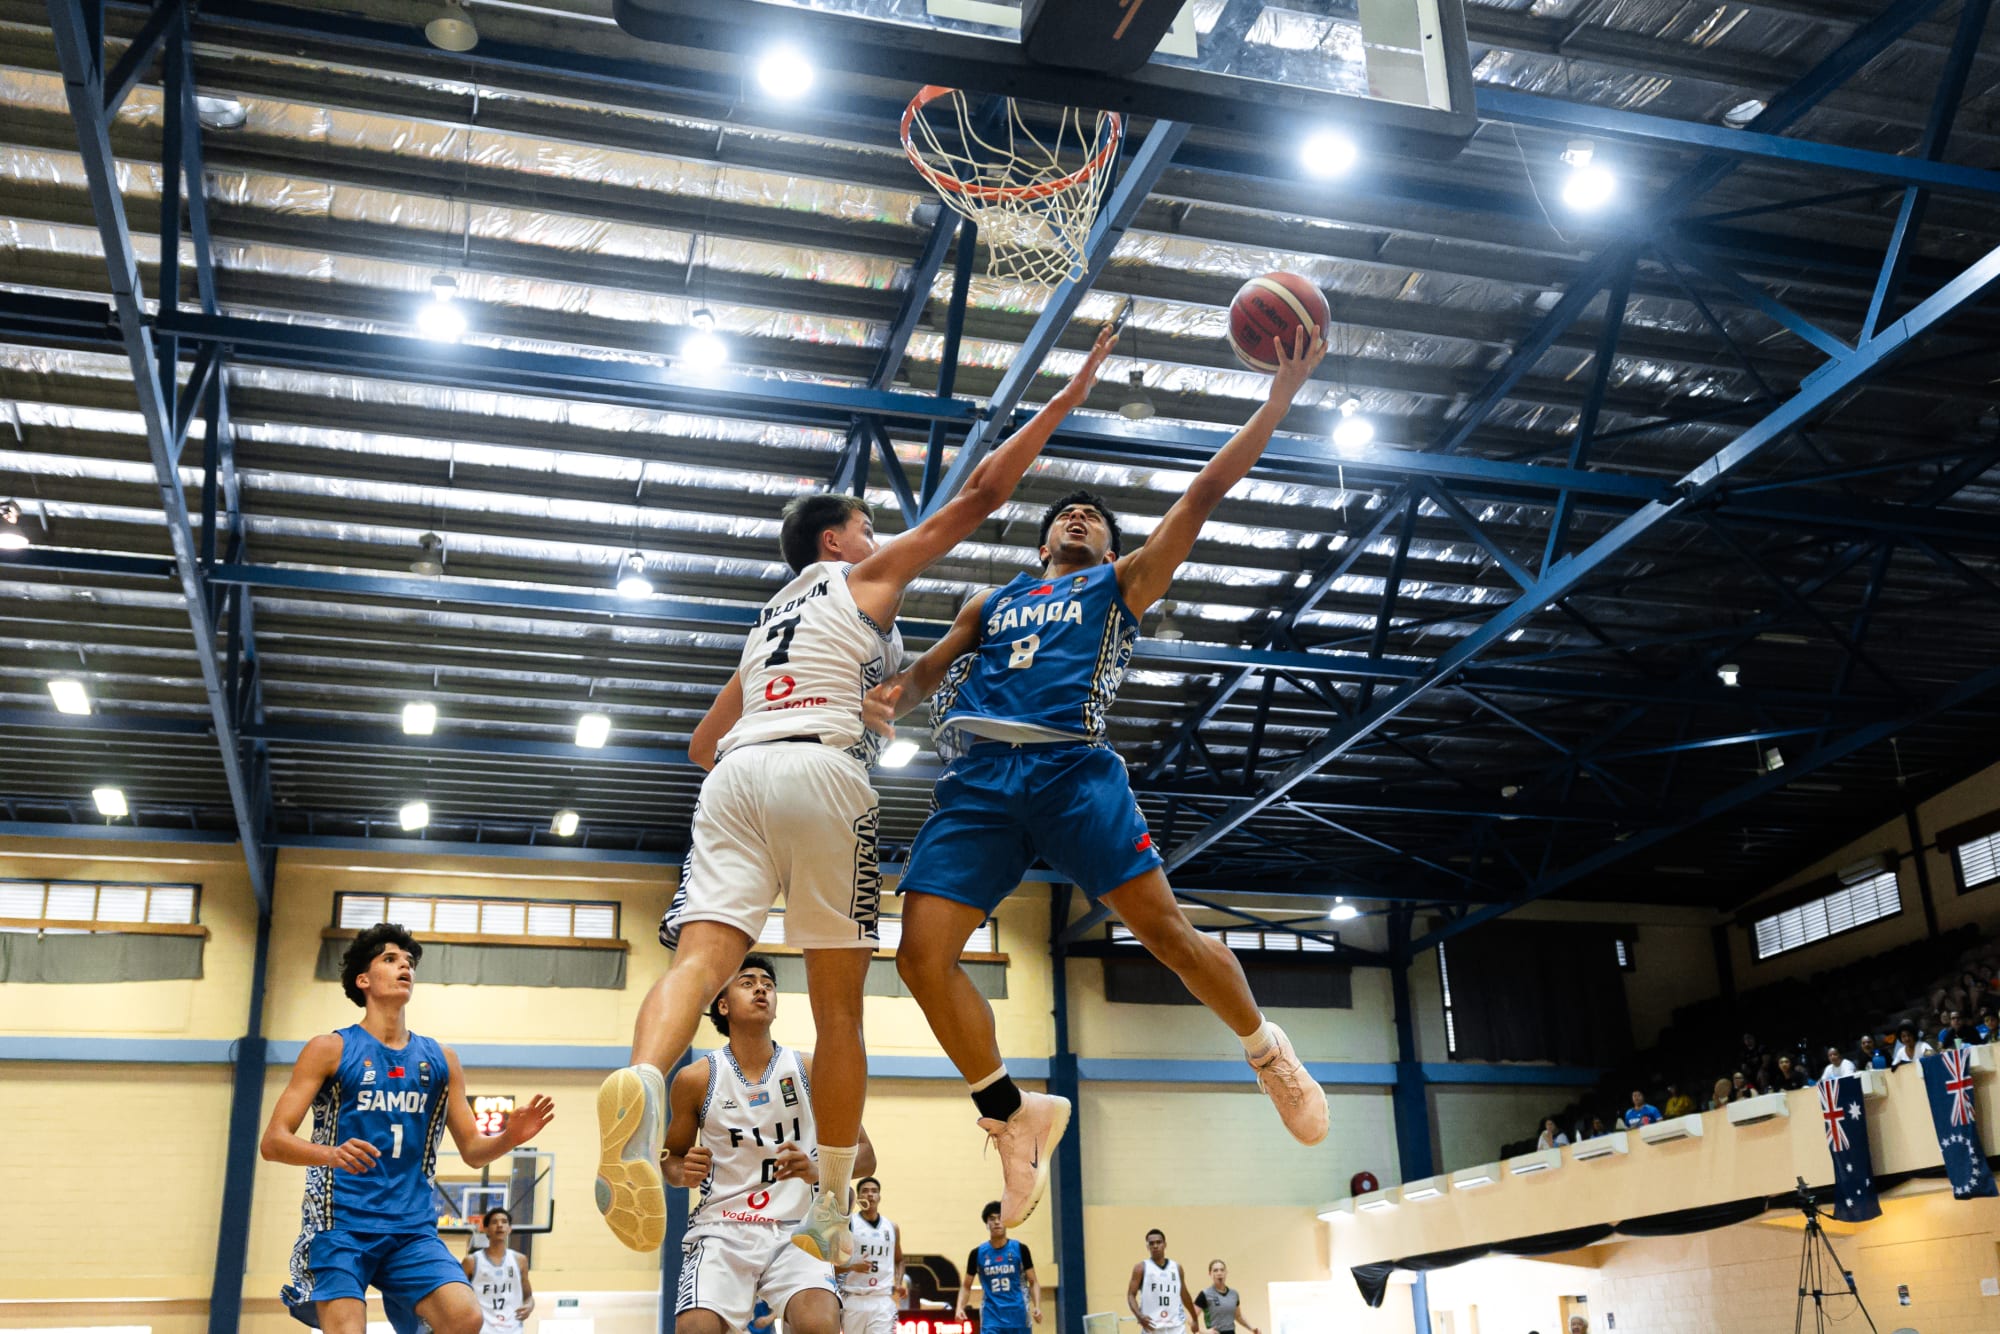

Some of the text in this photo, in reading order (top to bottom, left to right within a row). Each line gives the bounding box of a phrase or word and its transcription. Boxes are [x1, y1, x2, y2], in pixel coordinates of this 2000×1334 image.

[987, 600, 1083, 636] SAMOA
[765, 615, 801, 668] 7
[1008, 633, 1041, 669] 8
[475, 1112, 503, 1132] 22
[390, 1124, 404, 1159] 1
[728, 1117, 801, 1148] FIJI
[860, 1244, 889, 1257] FIJI
[482, 1283, 512, 1295] FIJI
[991, 1277, 1010, 1293] 29
[1151, 1282, 1177, 1294] FIJI
[492, 1298, 506, 1310] 17
[1158, 1295, 1170, 1307] 10
